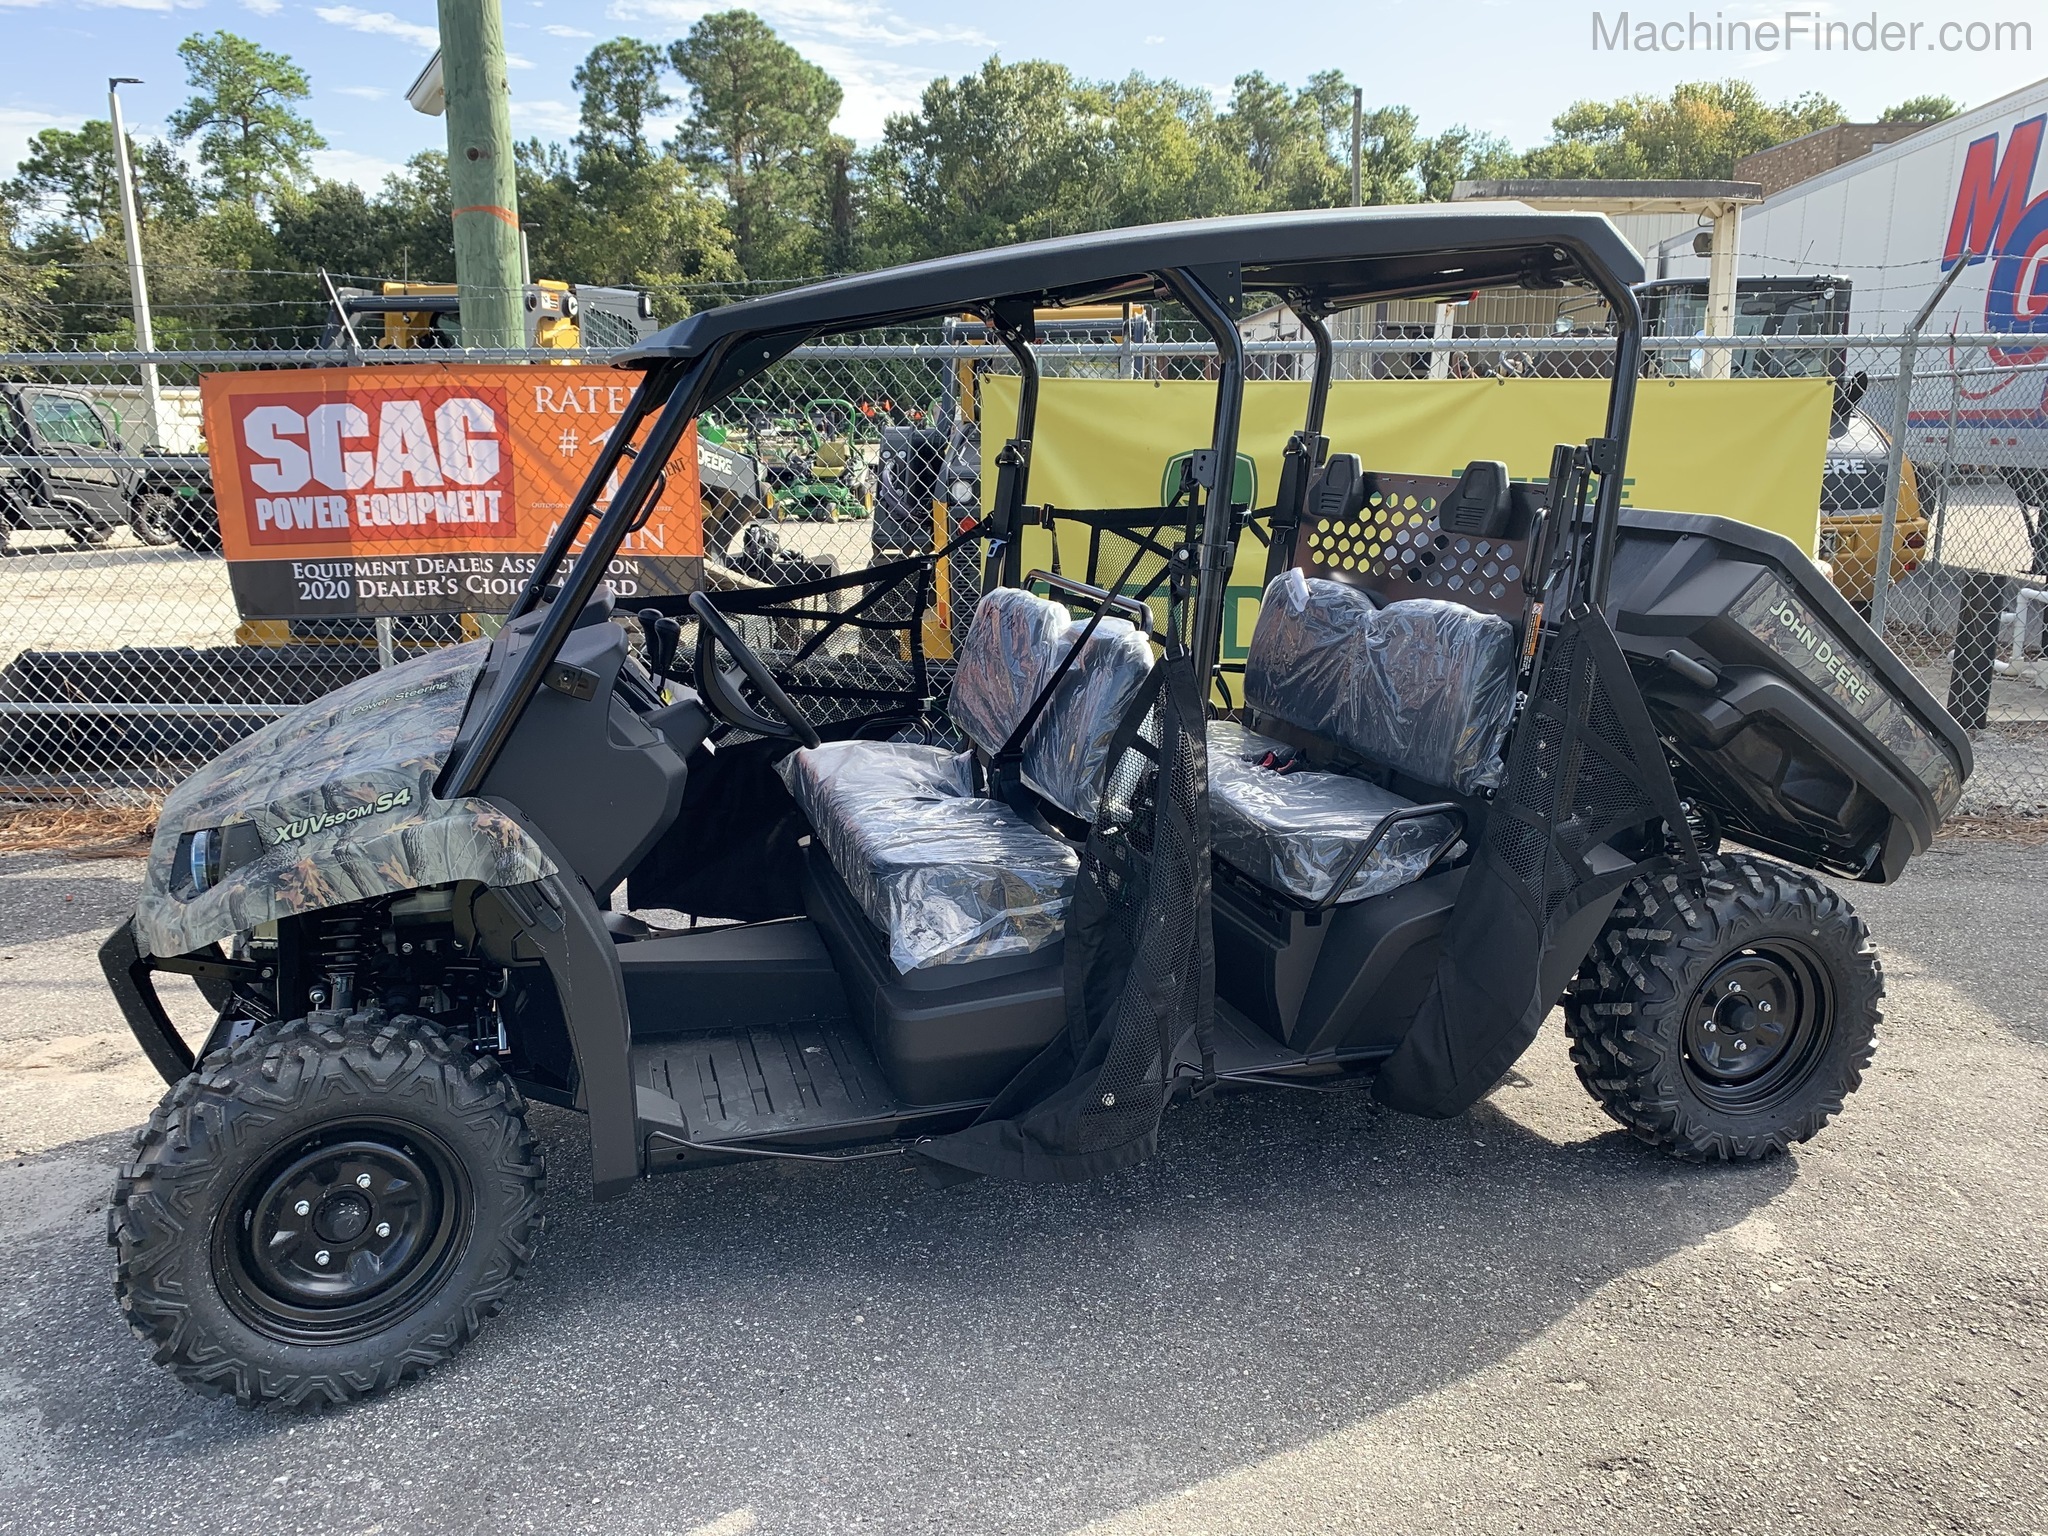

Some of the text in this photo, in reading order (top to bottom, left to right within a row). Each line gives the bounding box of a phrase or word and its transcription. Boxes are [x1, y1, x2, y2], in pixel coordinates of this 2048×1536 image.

[243, 397, 500, 493] SCAG
[697, 444, 733, 476] DEERE
[255, 490, 502, 531] POWER EQUIPMENT
[541, 520, 666, 550] AGIN
[291, 560, 410, 582] EQUIPMENT
[500, 557, 640, 575] ASSCION
[299, 575, 638, 601] 2020 DEALER'S CHOIC ARD
[1769, 600, 1871, 705] JOHN DEERE
[351, 681, 449, 715] Power Steering
[273, 787, 412, 846] XUV590M S4
